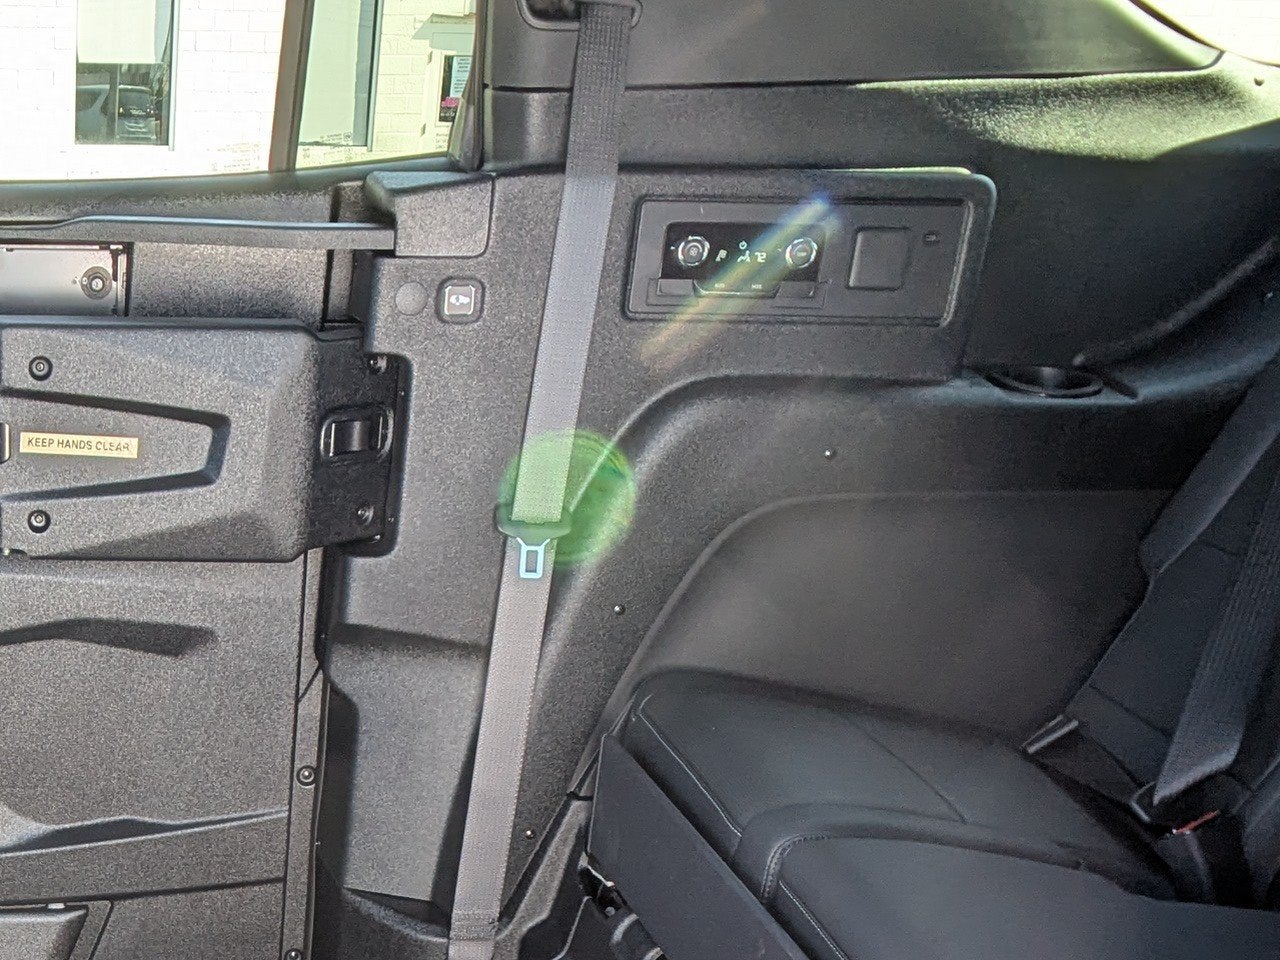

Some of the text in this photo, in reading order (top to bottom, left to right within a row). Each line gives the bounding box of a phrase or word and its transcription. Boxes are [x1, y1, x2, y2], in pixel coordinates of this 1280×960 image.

[27, 437, 131, 452] KEEP HANDS CLEAR
